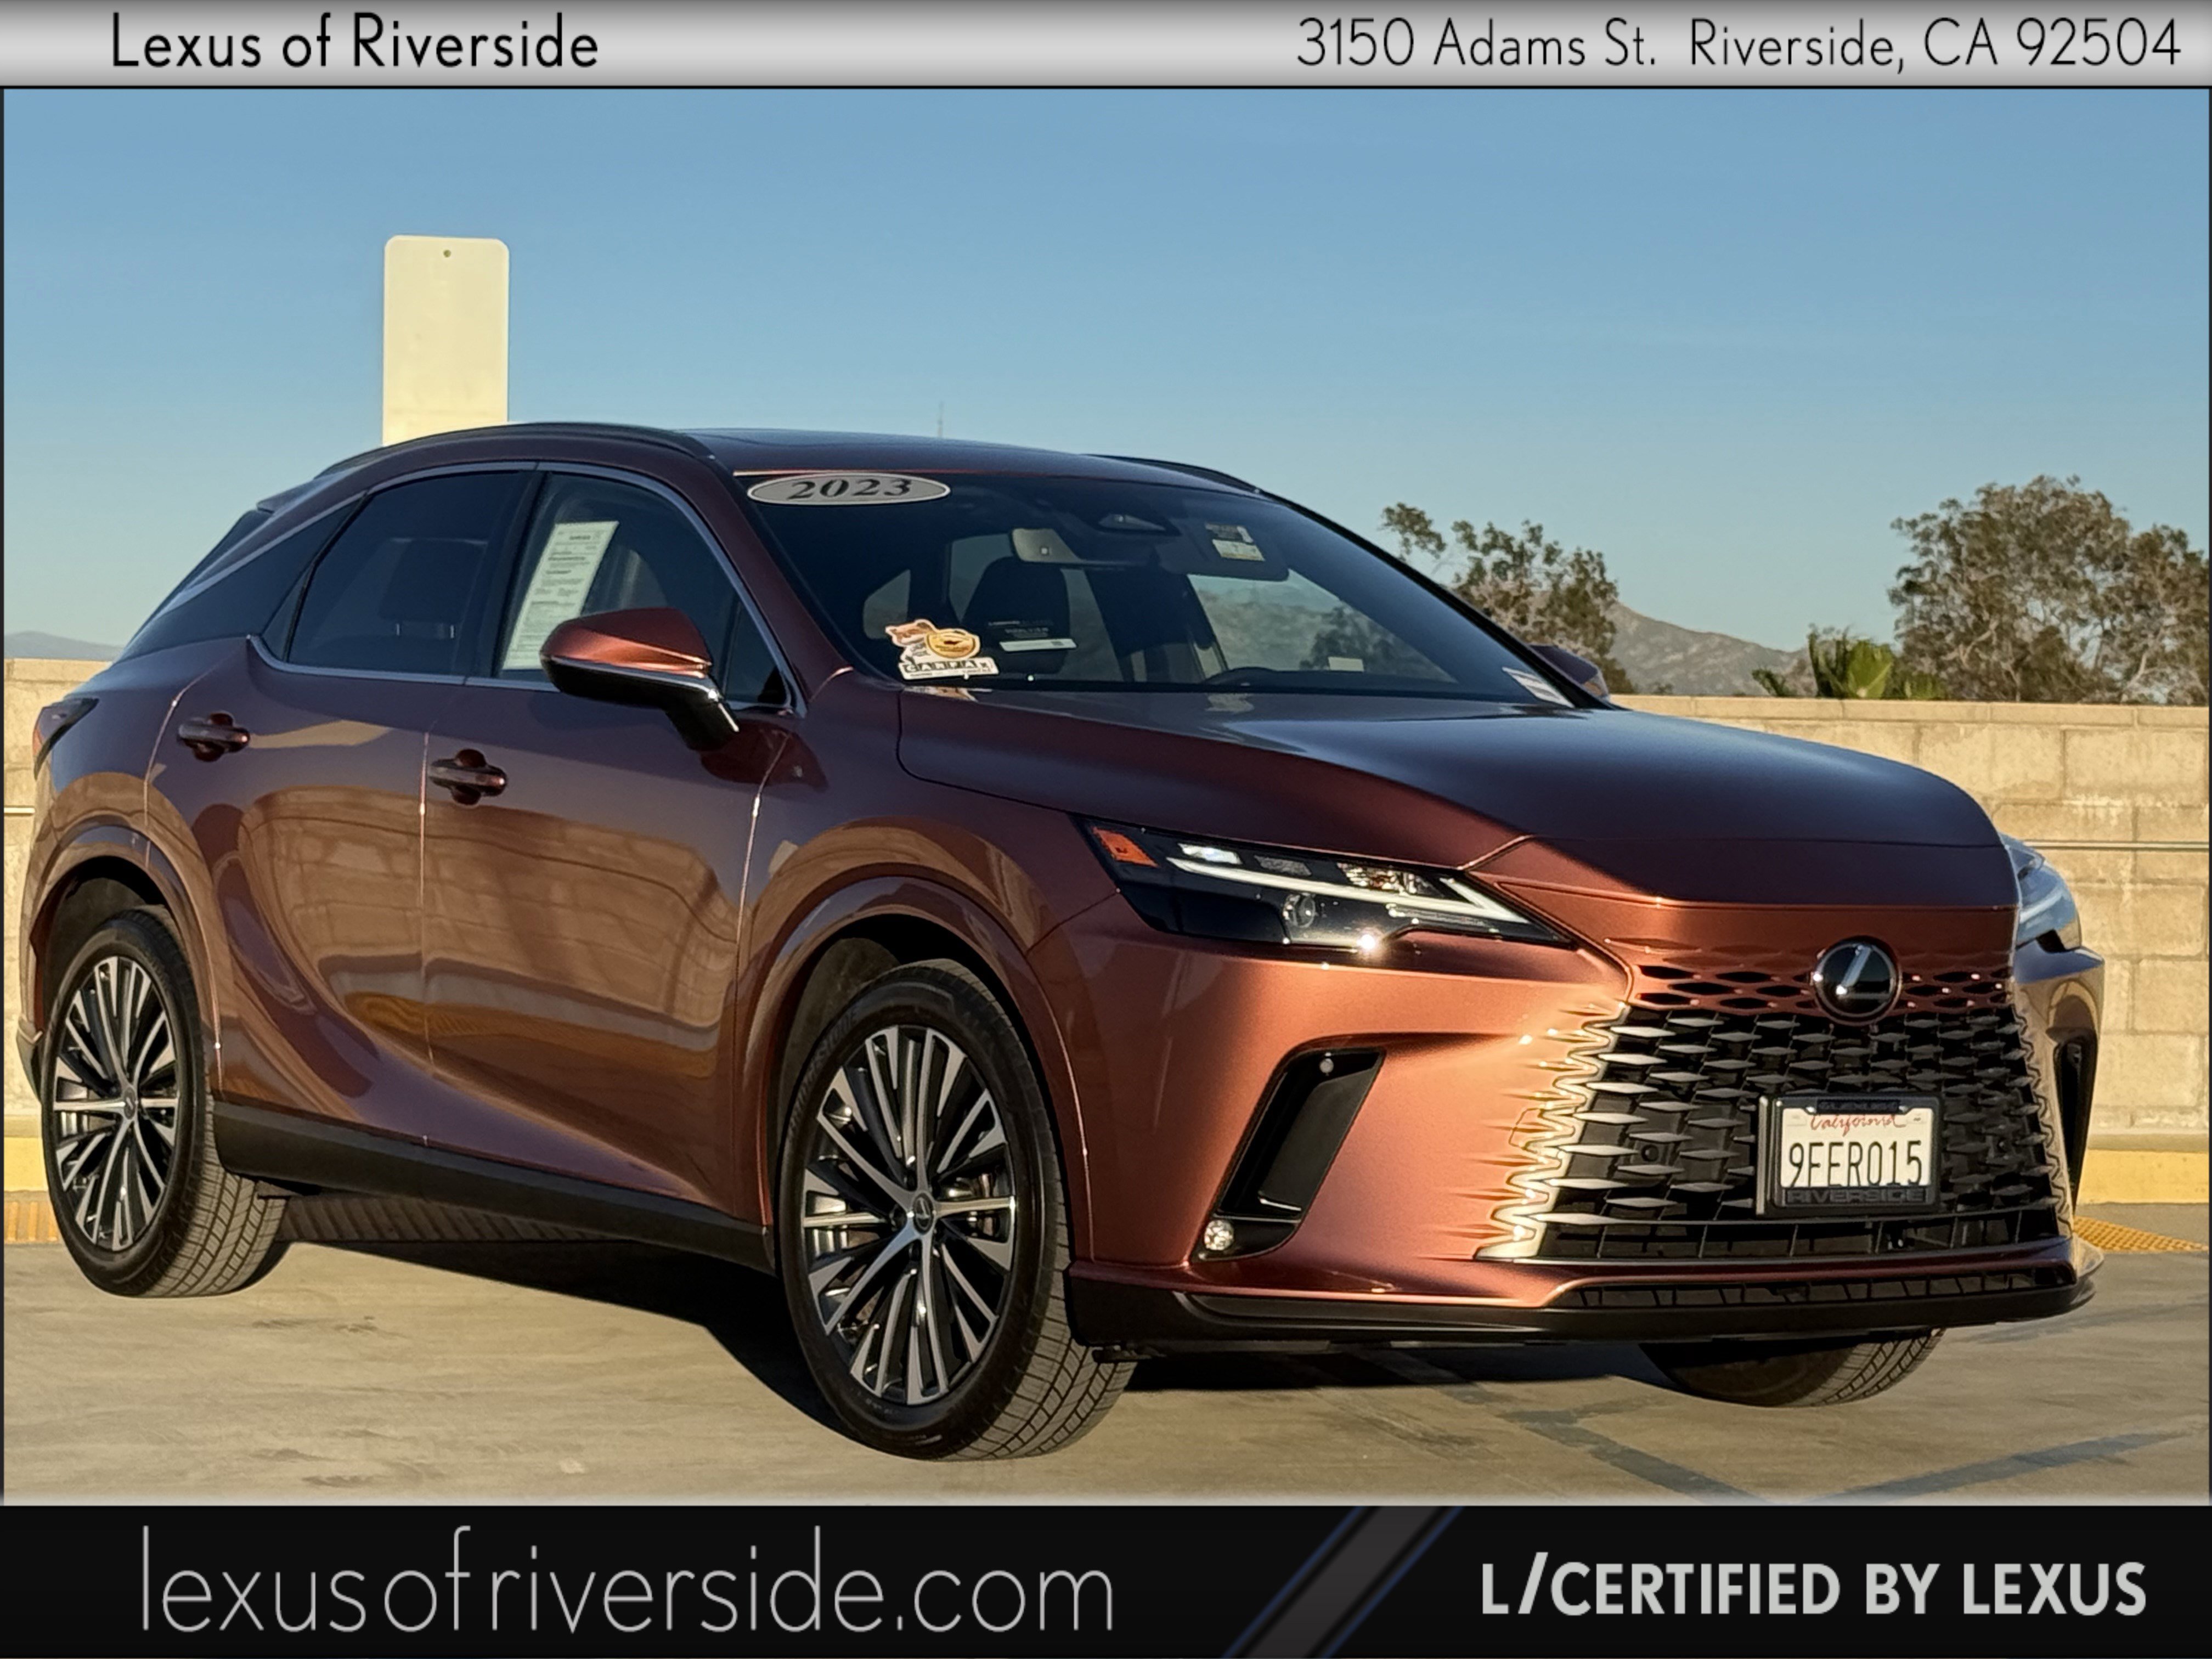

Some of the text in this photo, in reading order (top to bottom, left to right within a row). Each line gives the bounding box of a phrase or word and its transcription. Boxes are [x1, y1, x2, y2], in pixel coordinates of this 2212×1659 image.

[787, 478, 912, 500] 2023
[1810, 1114, 1906, 1137] California
[1788, 1141, 1922, 1187] 9FER015
[1787, 1189, 1924, 1203] RIVERSIDE
